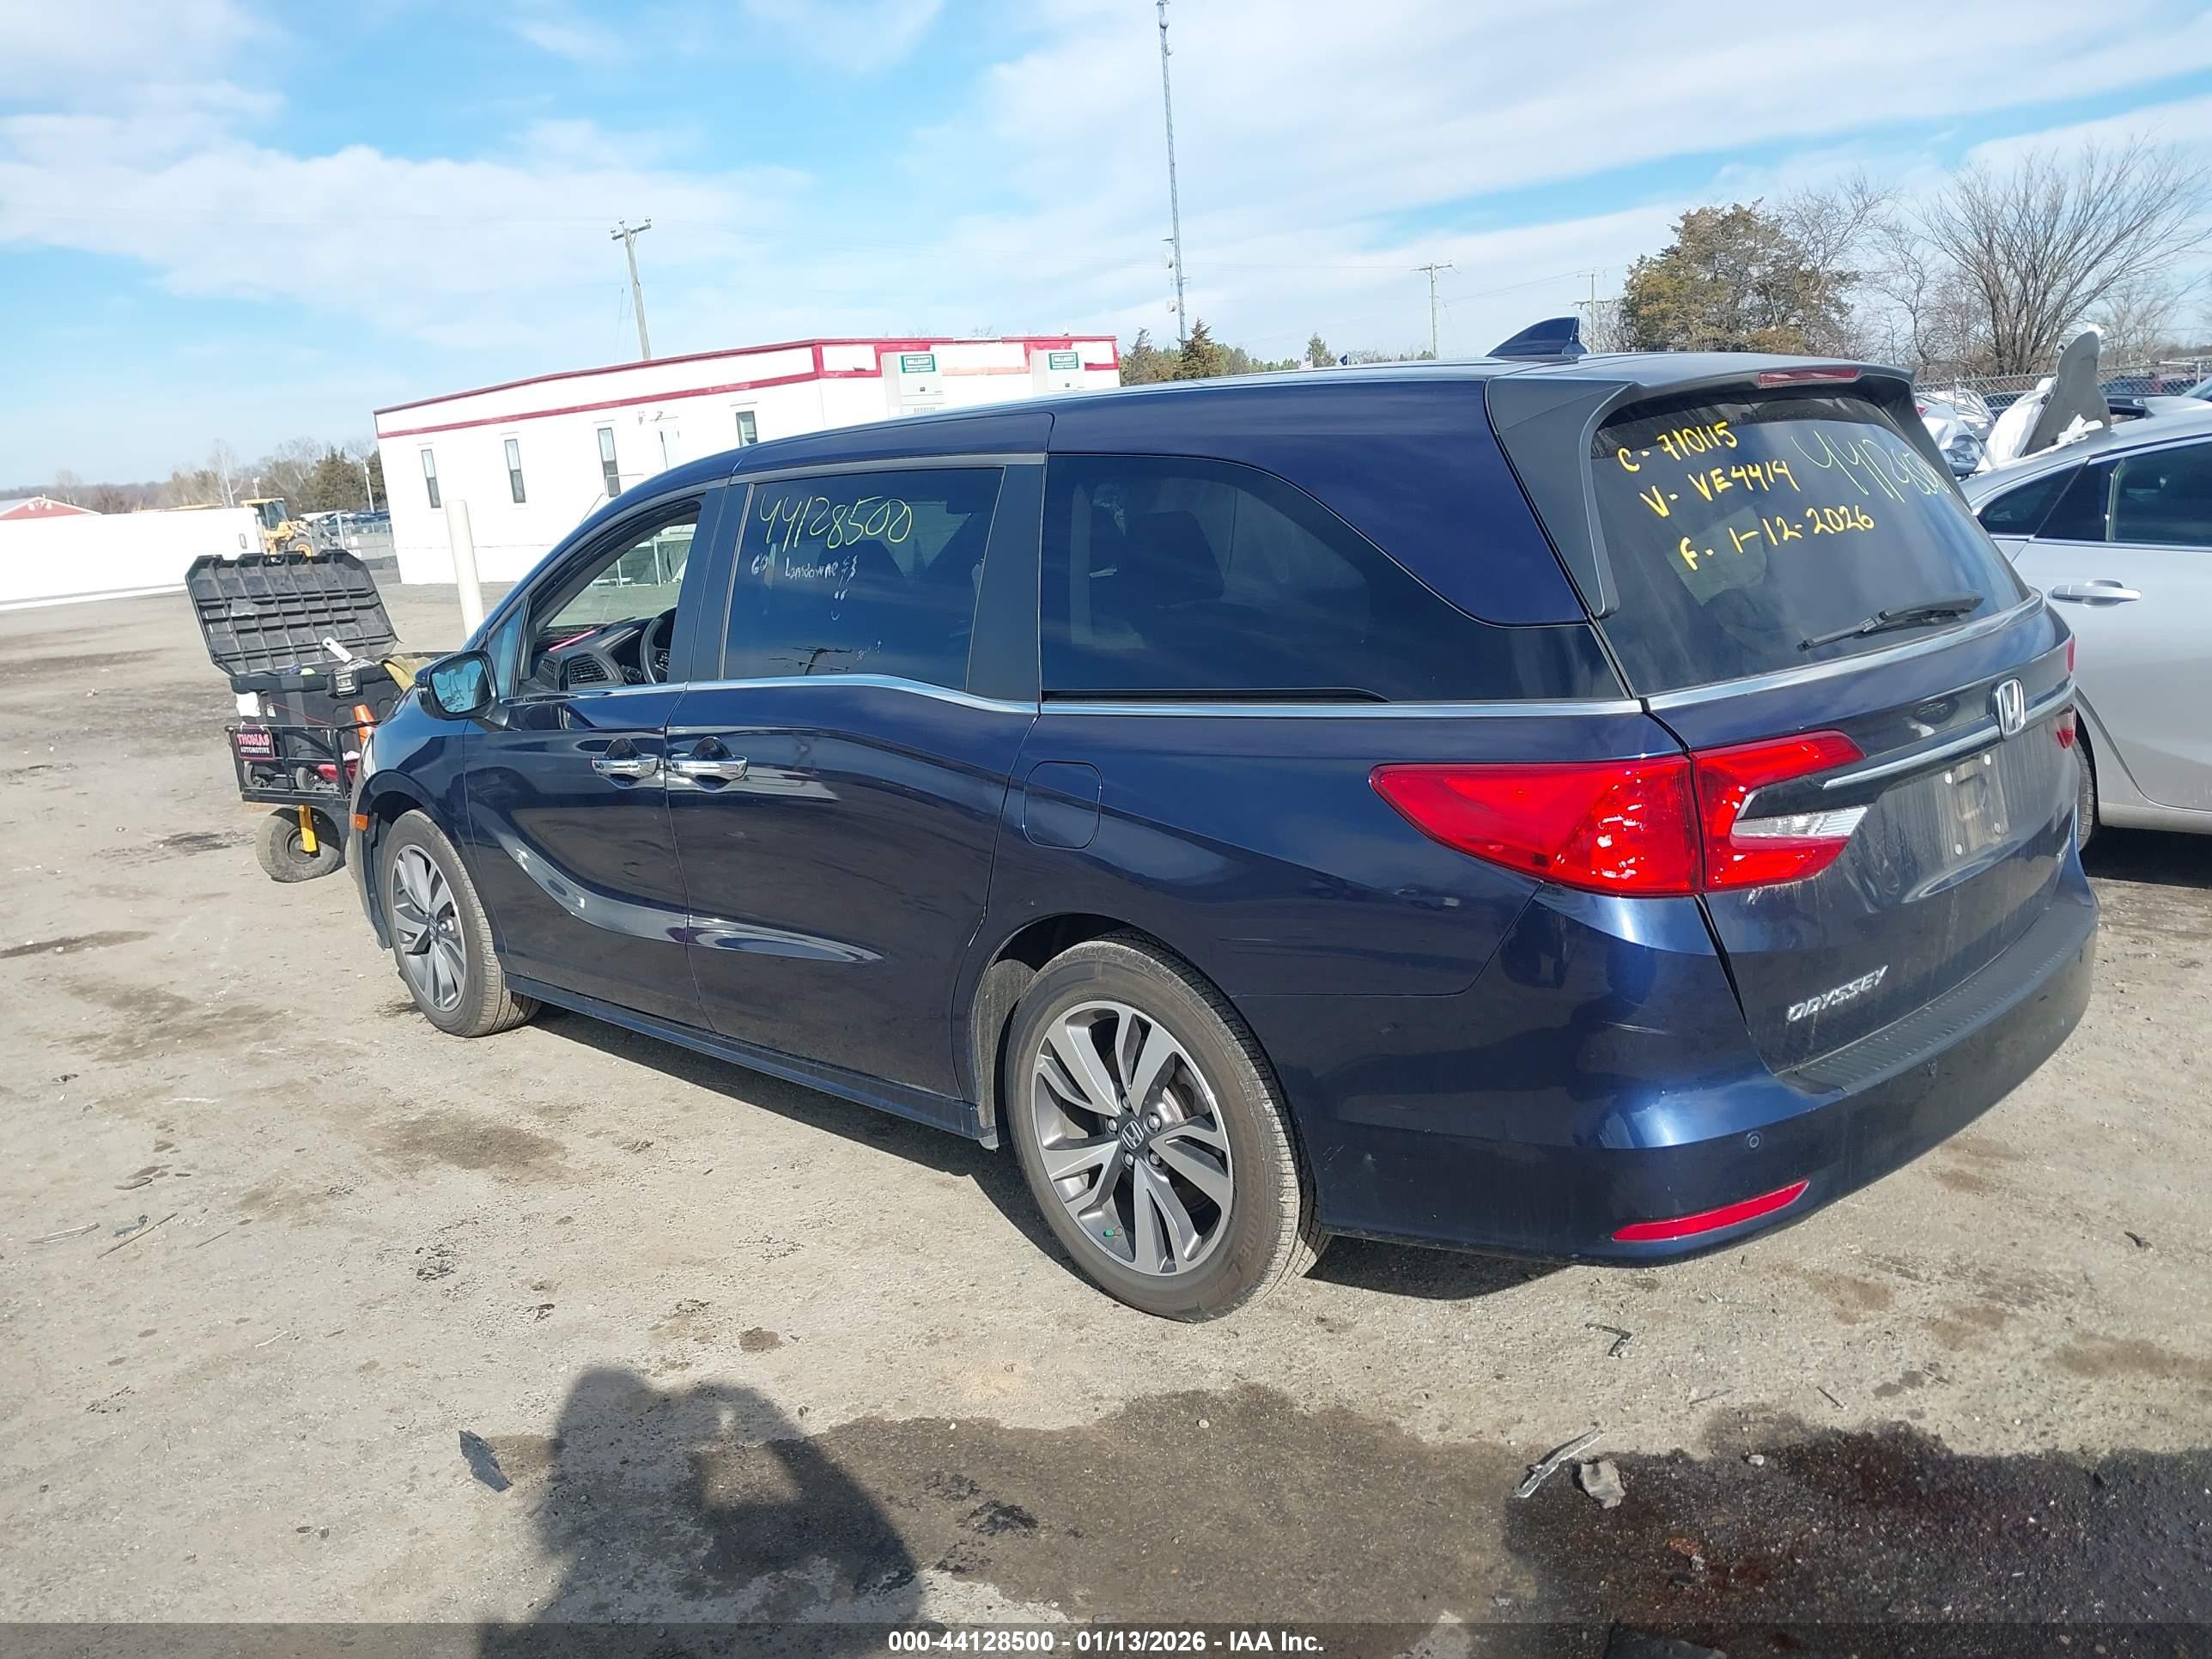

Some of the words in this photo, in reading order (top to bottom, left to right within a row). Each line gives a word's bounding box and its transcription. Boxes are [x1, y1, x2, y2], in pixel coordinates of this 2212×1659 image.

[1656, 422, 1738, 460] 710115
[1687, 459, 1802, 501] VE4414
[760, 493, 912, 552] 44128500
[237, 733, 270, 746] THOMAS
[1786, 965, 1888, 1022] ODYSSEY
